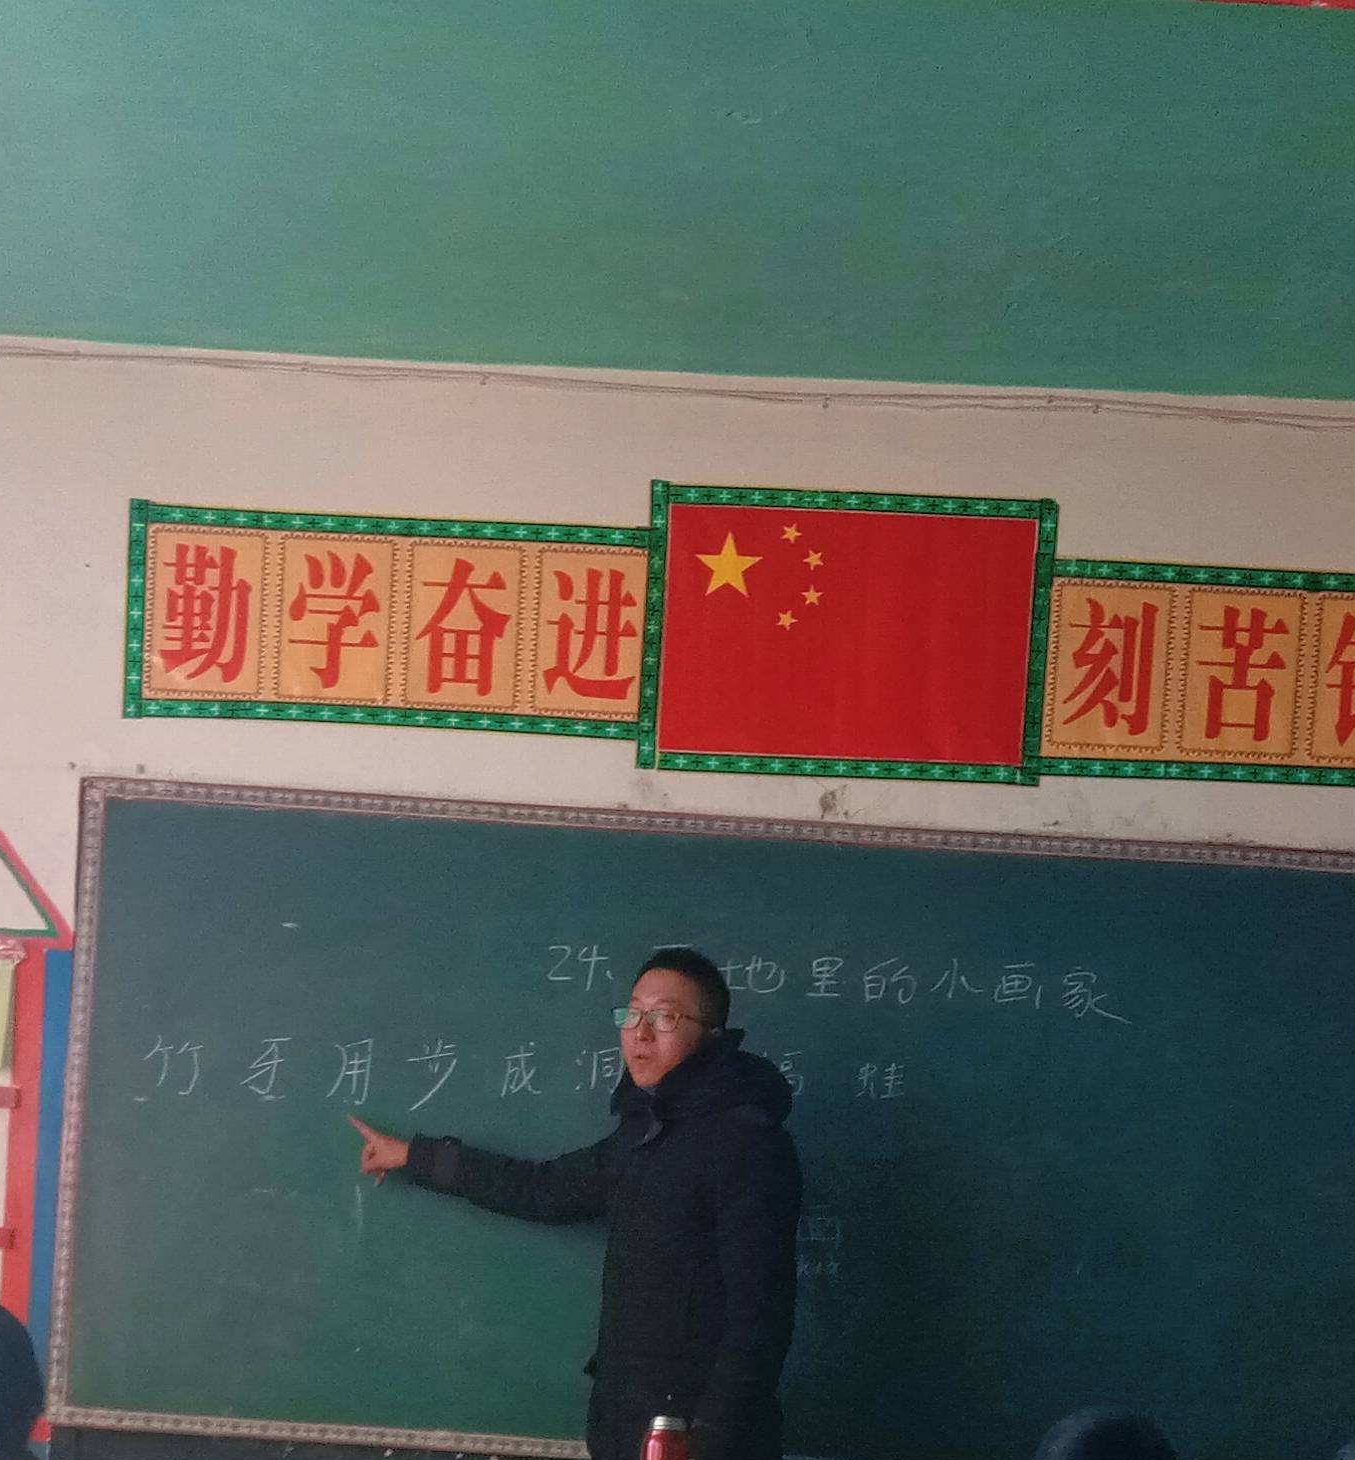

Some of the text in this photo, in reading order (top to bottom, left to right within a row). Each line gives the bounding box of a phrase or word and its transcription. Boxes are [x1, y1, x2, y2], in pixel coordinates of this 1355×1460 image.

[158, 542, 639, 701] 勤学奋进
[652, 943, 1133, 1025] 地里的小画家
